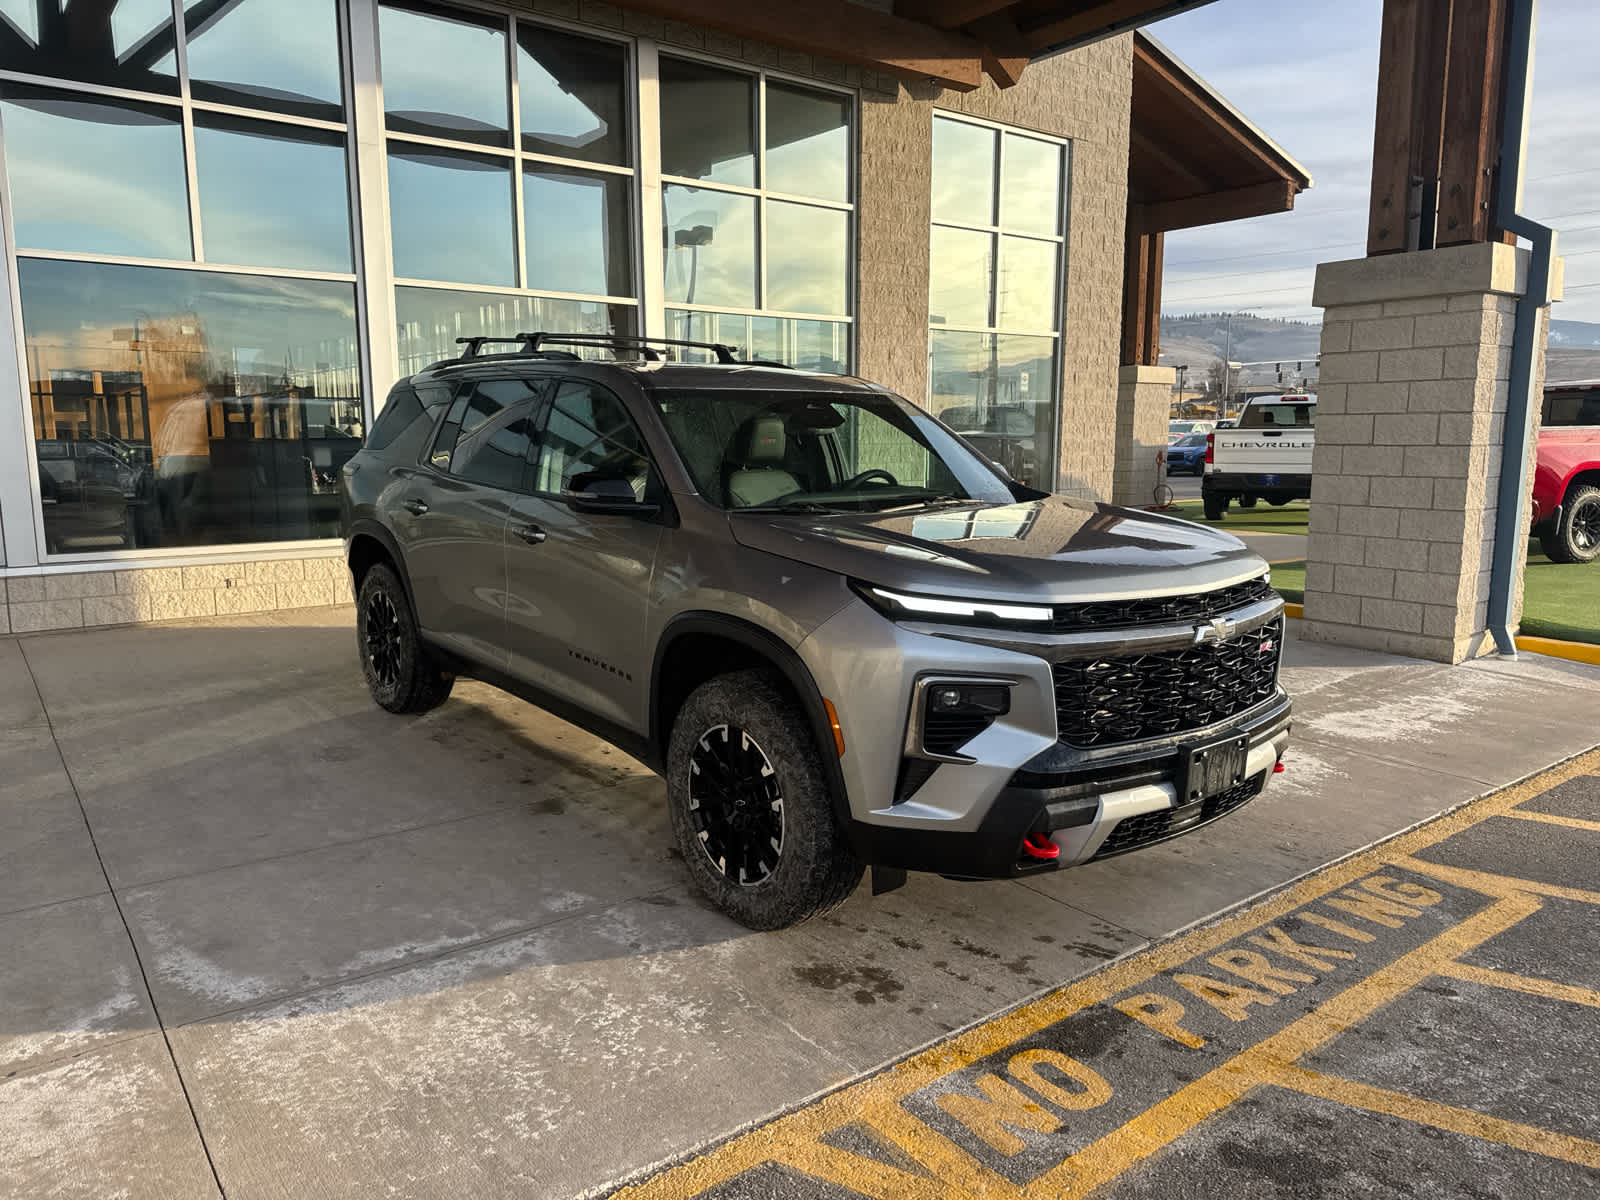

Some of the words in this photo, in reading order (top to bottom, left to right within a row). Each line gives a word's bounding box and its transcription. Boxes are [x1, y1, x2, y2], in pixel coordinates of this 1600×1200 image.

[1221, 441, 1314, 449] CHEVROLE
[934, 1049, 1113, 1157] NO
[1113, 875, 1443, 1050] PARKING
